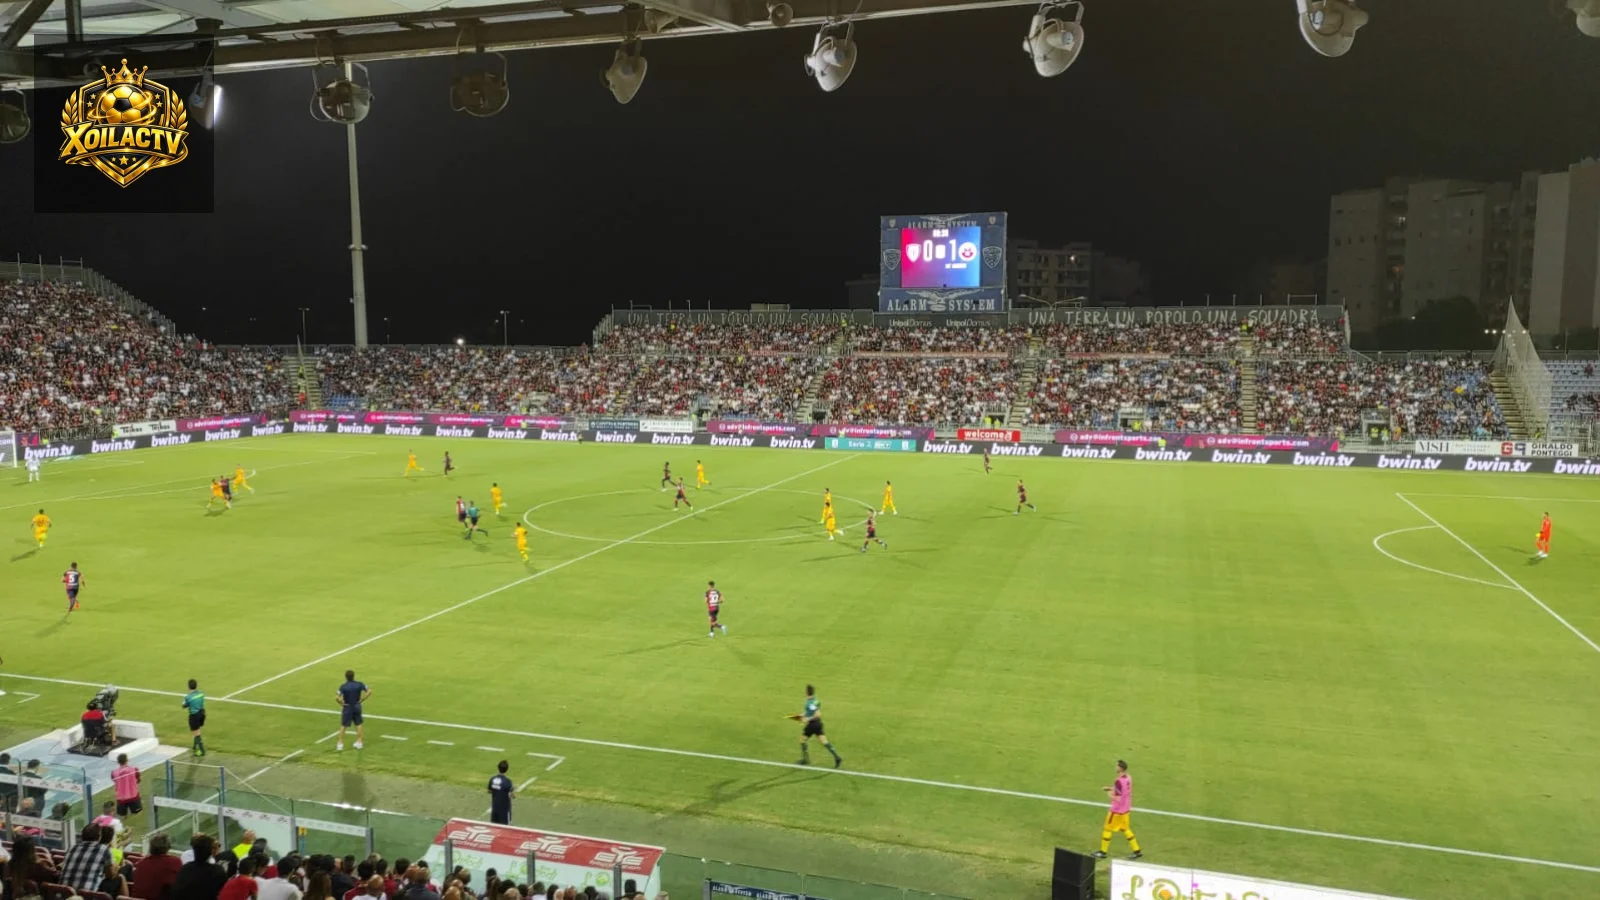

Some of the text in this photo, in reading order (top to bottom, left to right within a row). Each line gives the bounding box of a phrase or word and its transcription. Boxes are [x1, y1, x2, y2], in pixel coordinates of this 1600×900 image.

[923, 239, 933, 262] 0
[949, 239, 957, 262] 1
[887, 299, 995, 311] ALARM SYSTEM
[293, 422, 328, 433] bwin.tv
[337, 423, 374, 434] bwin.tv
[385, 424, 422, 436] bwin.tv
[436, 425, 474, 437] bwin.tv
[488, 427, 527, 439] bwin.tv
[151, 433, 191, 447] bwin.tv
[205, 428, 241, 441] bwin.tv
[595, 431, 637, 443] bwin.tv
[652, 432, 695, 445] bwin.tv
[710, 434, 754, 447] bwin.tv
[91, 439, 136, 453] bwin.tv
[770, 436, 816, 449] bwin.tv
[922, 441, 973, 454] bwin.tv
[24, 444, 75, 460] bwin.tv
[991, 443, 1043, 456] bwin.tv
[1061, 445, 1116, 459] bwin.tv
[1135, 447, 1192, 461] bwin.tv
[1211, 449, 1271, 464] bwin.tv
[1292, 451, 1355, 466] bwin.tv
[1377, 454, 1442, 470] bwin.tv
[1464, 457, 1532, 472] bwin.tv
